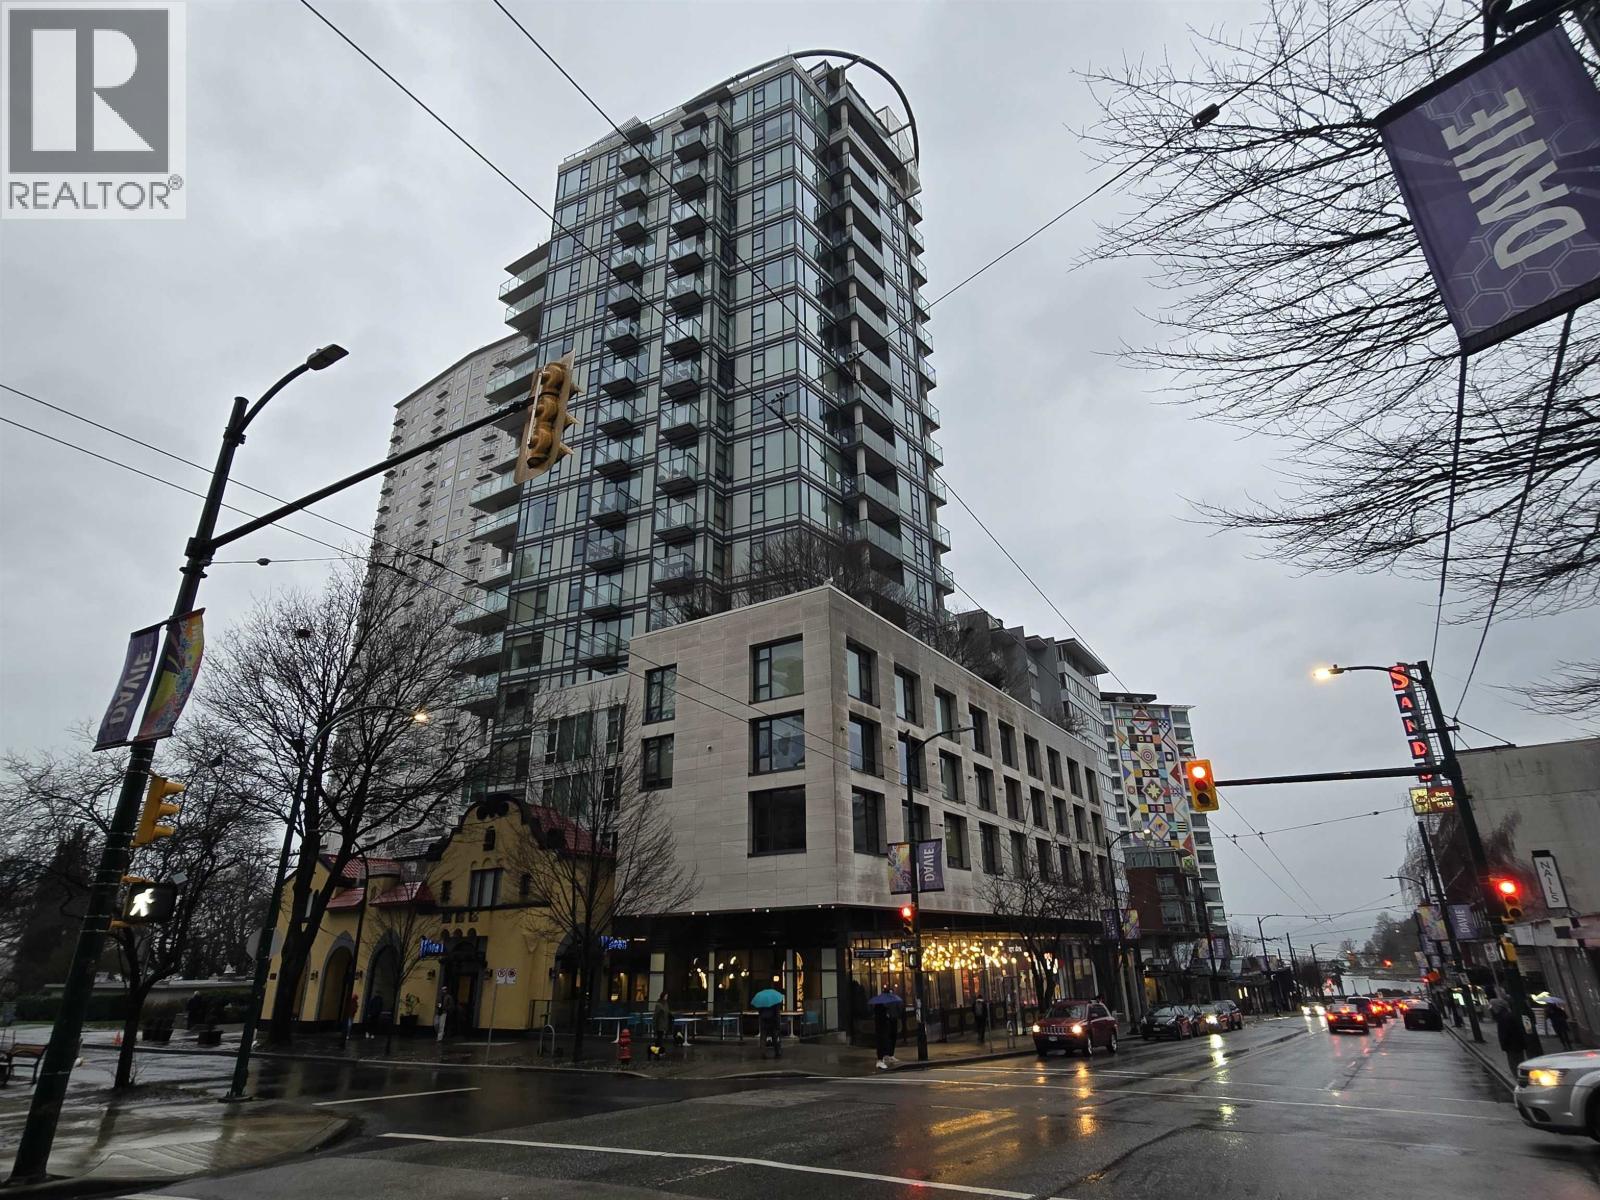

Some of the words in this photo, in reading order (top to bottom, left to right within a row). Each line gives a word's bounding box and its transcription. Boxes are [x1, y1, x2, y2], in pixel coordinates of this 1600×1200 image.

[1440, 86, 1587, 271] DAVIE
[1540, 861, 1560, 902] NAILS
[1455, 909, 1471, 933] DAVIE
